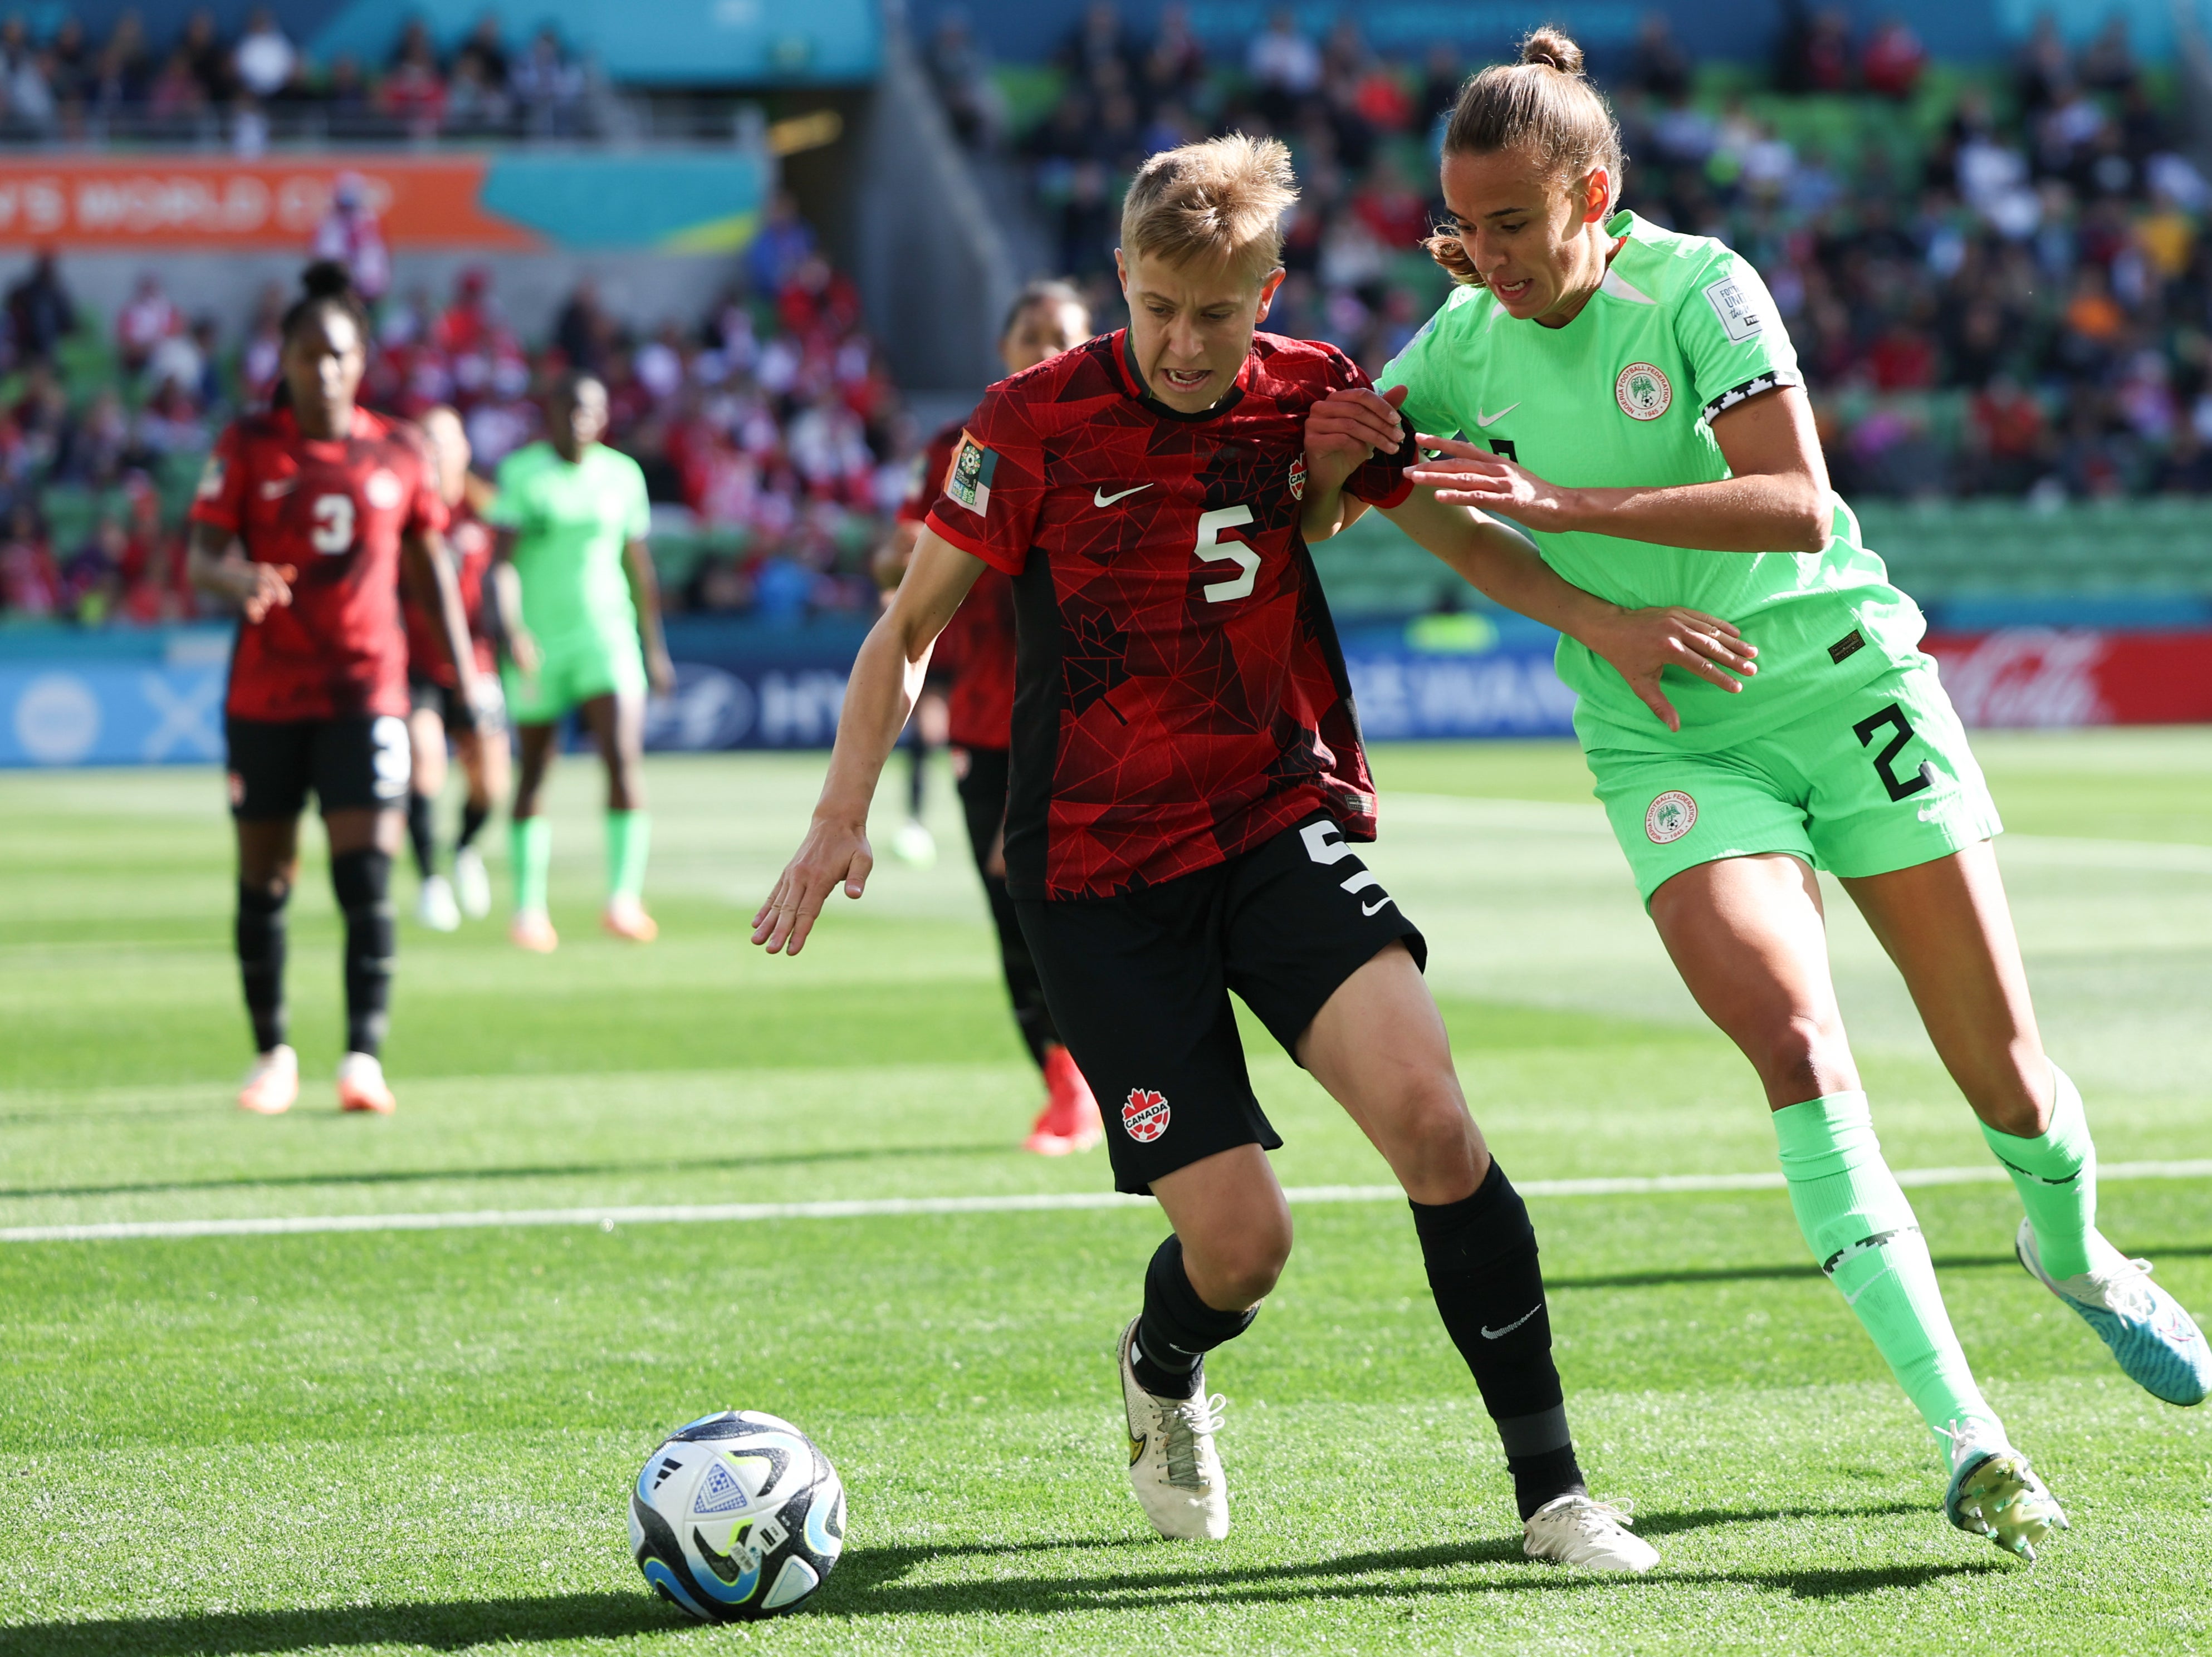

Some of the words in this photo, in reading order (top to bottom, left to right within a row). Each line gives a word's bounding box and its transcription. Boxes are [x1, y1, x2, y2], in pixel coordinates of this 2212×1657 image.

[1619, 366, 1646, 387] FOOTBALL
[1647, 366, 1669, 403] FEDERATION
[1618, 389, 1634, 414] NIGERIA
[311, 493, 355, 555] 3
[1194, 504, 1261, 603] 5
[1852, 703, 1935, 802] 2
[1648, 795, 1672, 821] FOOTBALL
[1673, 793, 1694, 822] FEDERATION
[1648, 822, 1662, 840] NIGERIA
[1671, 829, 1684, 839] 1945
[1126, 1103, 1167, 1128] CANADA
